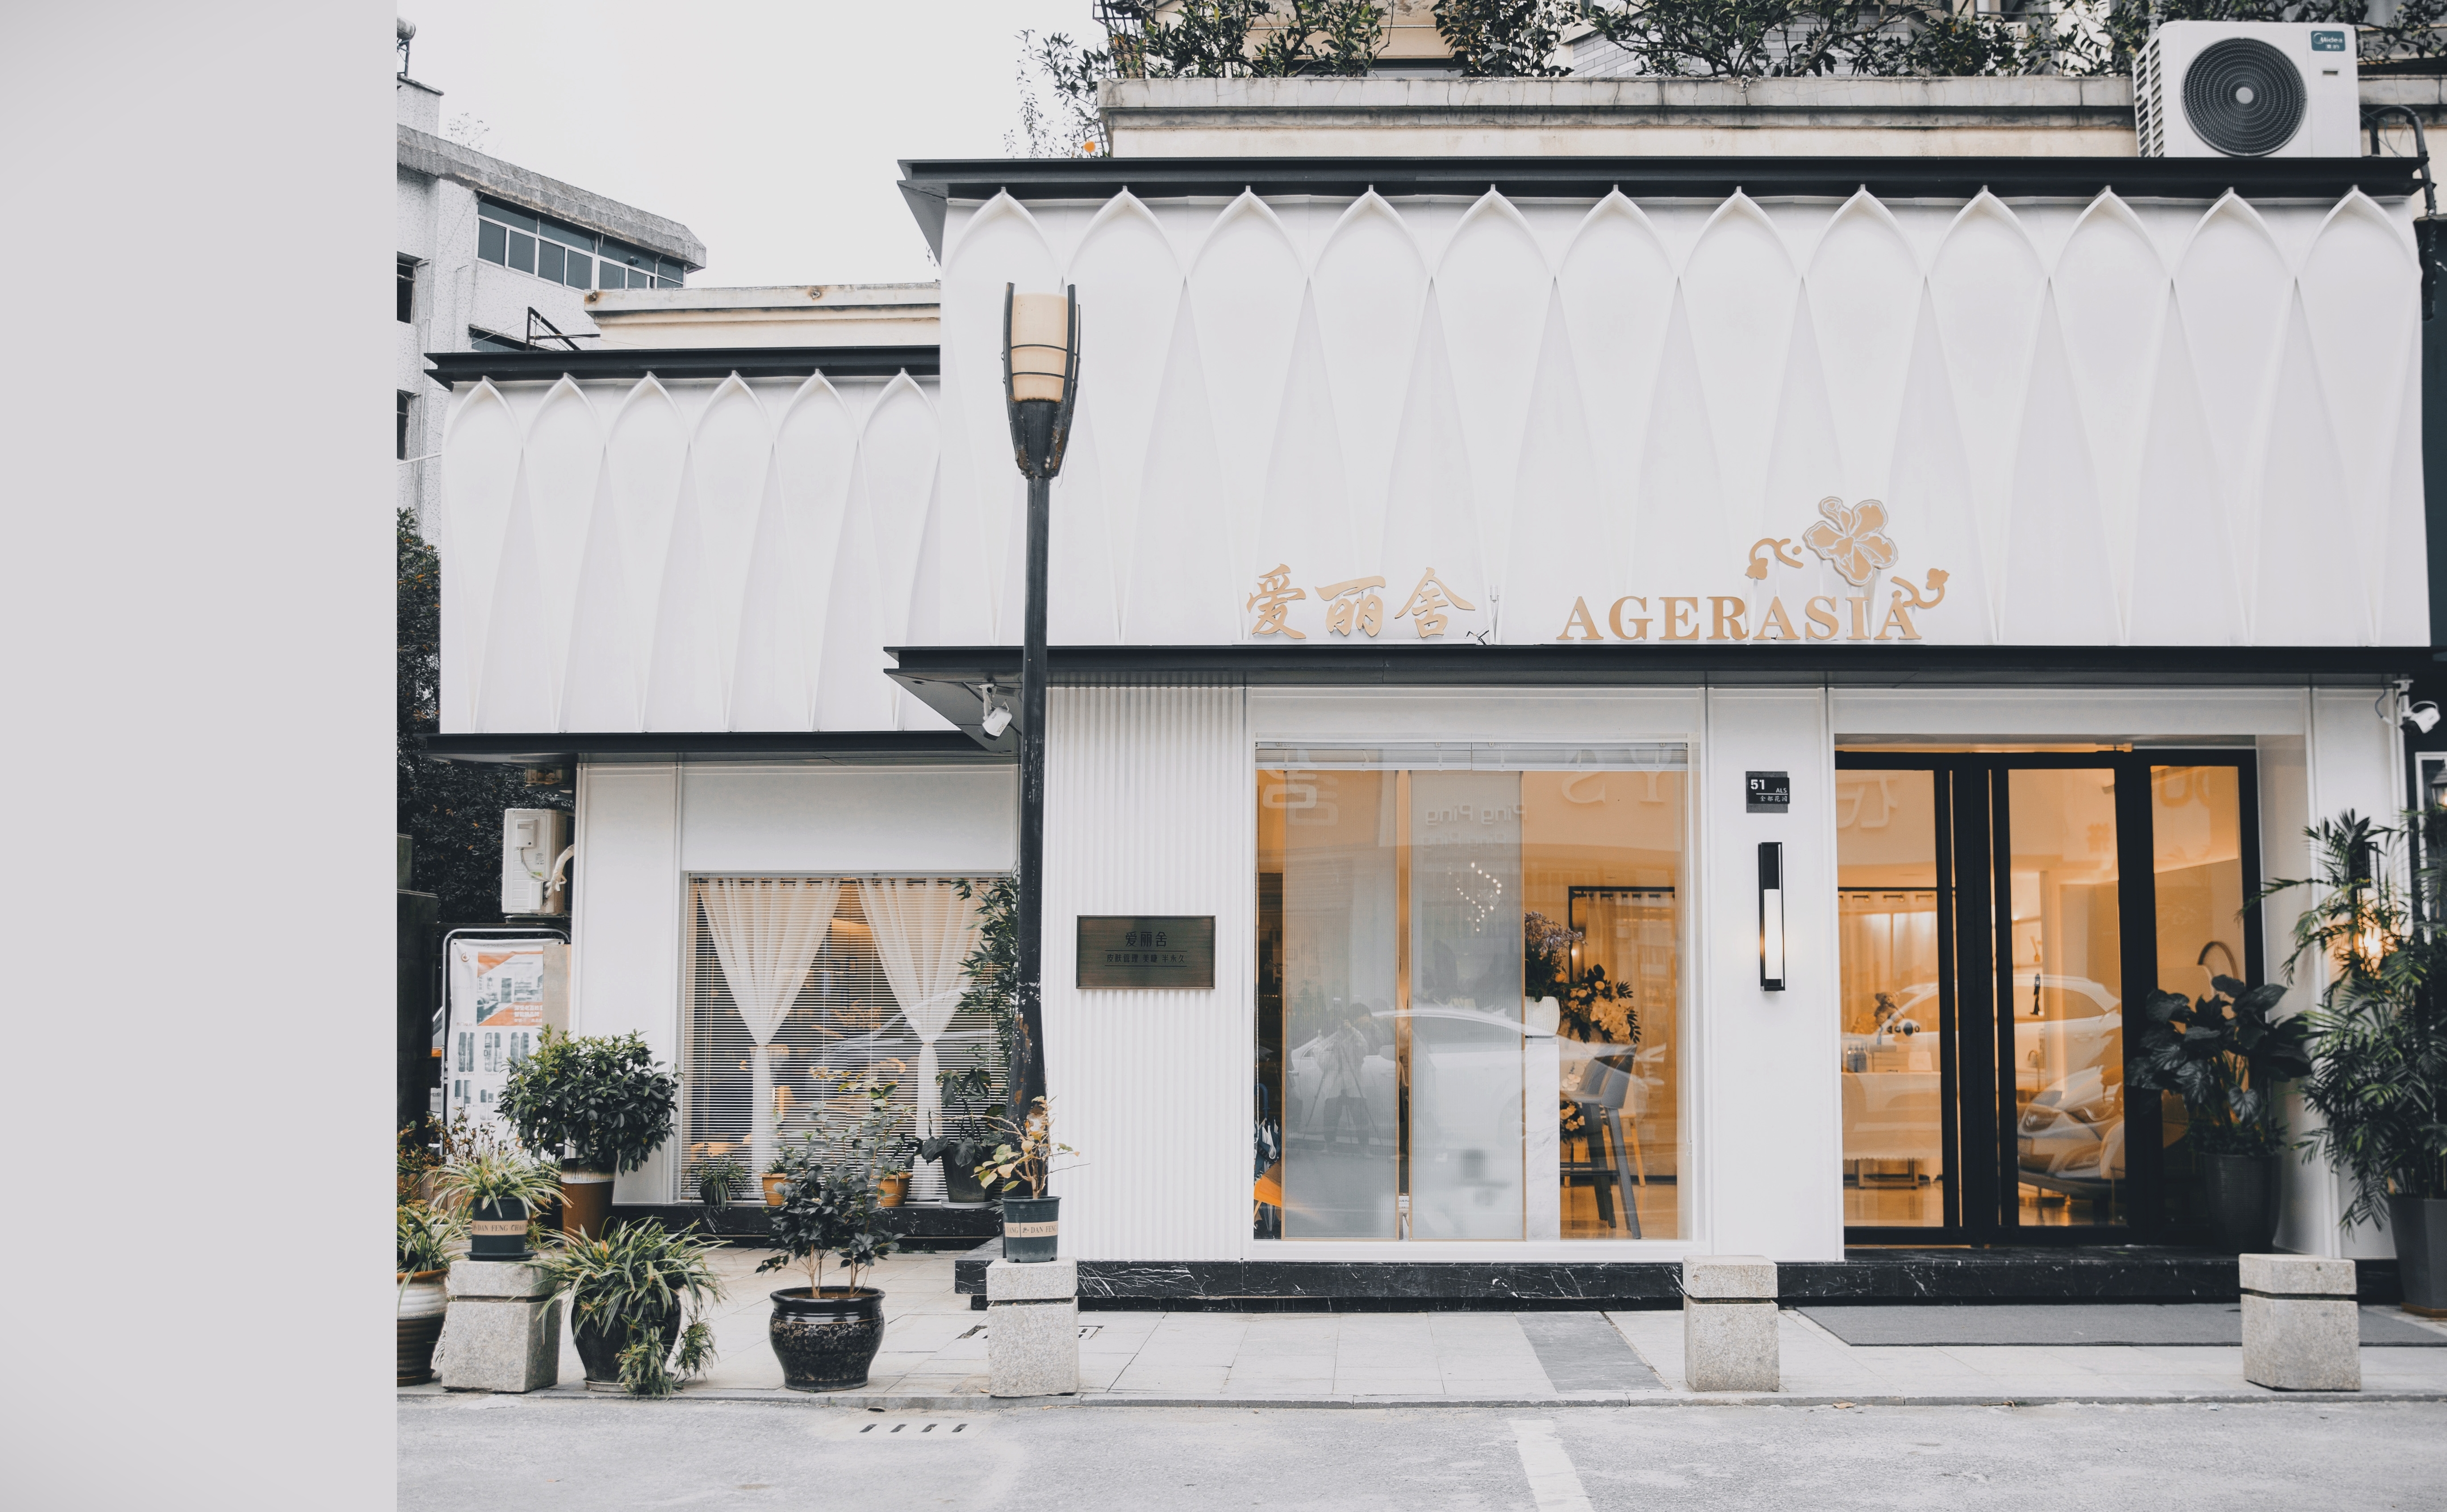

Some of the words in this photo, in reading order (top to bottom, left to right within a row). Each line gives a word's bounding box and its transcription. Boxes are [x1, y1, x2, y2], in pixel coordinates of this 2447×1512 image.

[1246, 563, 1475, 639] 爱丽舍
[1556, 595, 1922, 640] AGERASIA
[1750, 779, 1765, 790] 51
[1125, 931, 1168, 947] 爱丽舍
[1107, 954, 1139, 963] 皮肤管理
[1162, 954, 1185, 963] 半永久
